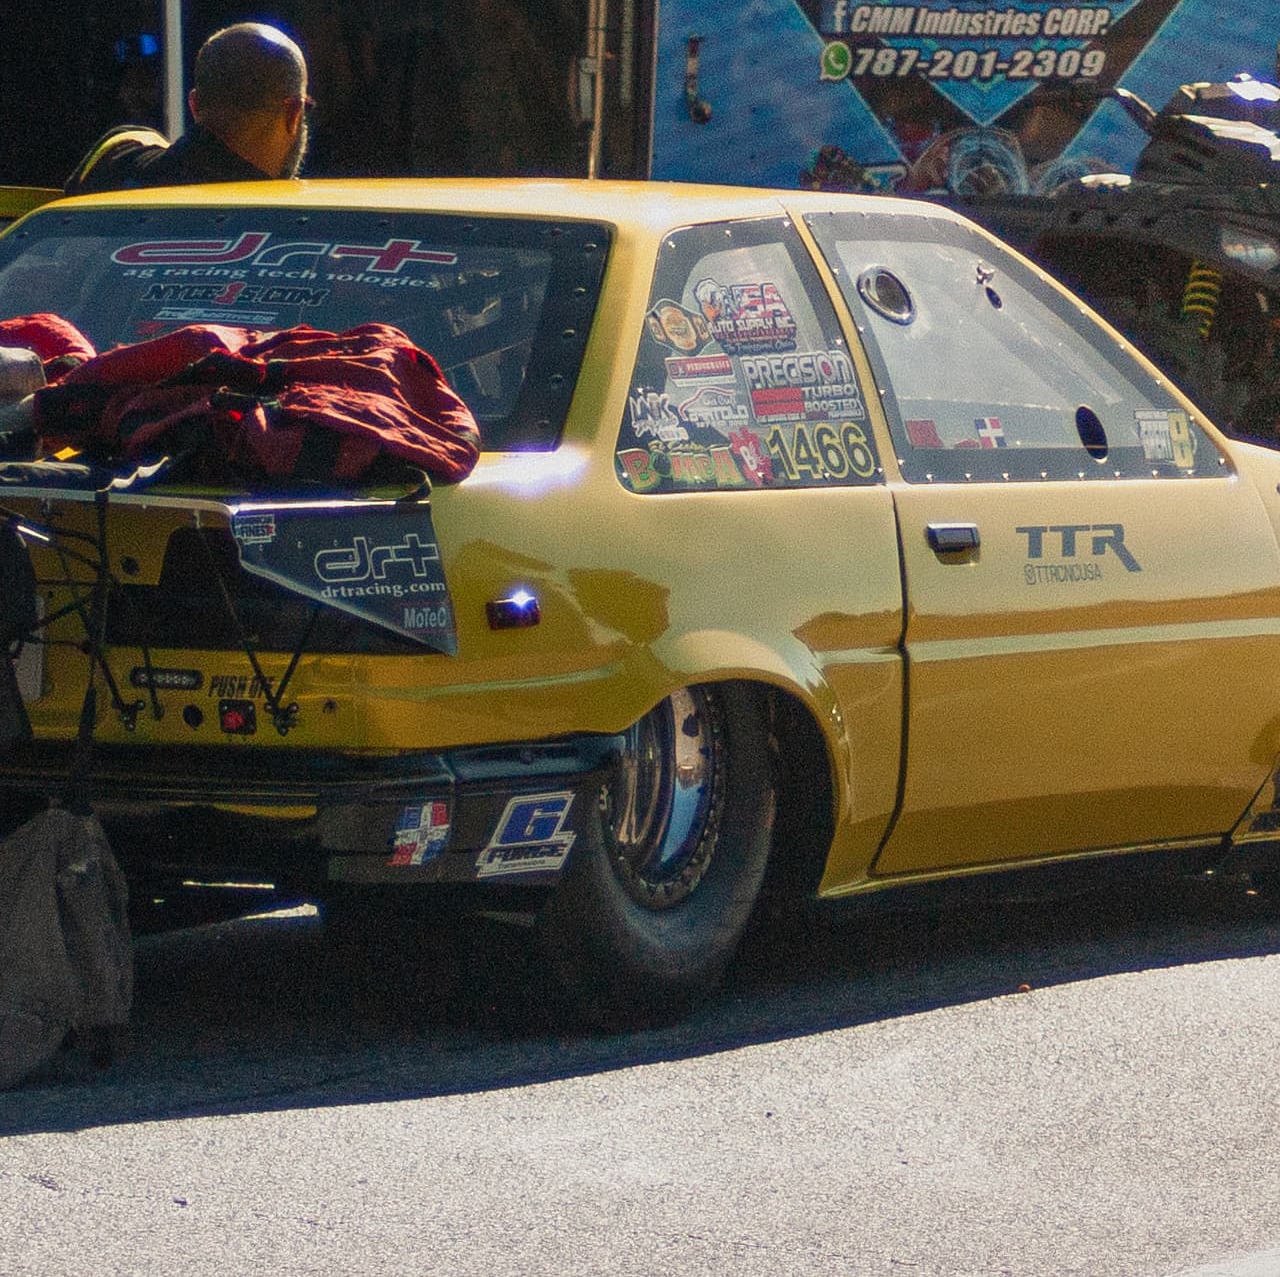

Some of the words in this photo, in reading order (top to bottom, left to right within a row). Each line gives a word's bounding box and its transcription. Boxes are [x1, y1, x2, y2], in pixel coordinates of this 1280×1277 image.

[851, 6, 915, 35] CMM
[916, 7, 1041, 37] Industries
[1043, 8, 1112, 37] CORP.
[853, 47, 1107, 79] 787-201-2309
[162, 265, 249, 282] racing
[256, 267, 439, 290] technologies
[743, 352, 853, 388] PRECISION
[802, 384, 855, 399] TURBO
[805, 399, 858, 413] BOOSTED
[766, 421, 875, 480] 1466
[1015, 523, 1143, 573] TTR
[320, 580, 446, 599] drtracing.com
[403, 606, 448, 629] MoTeC
[208, 674, 247, 699] PUSH
